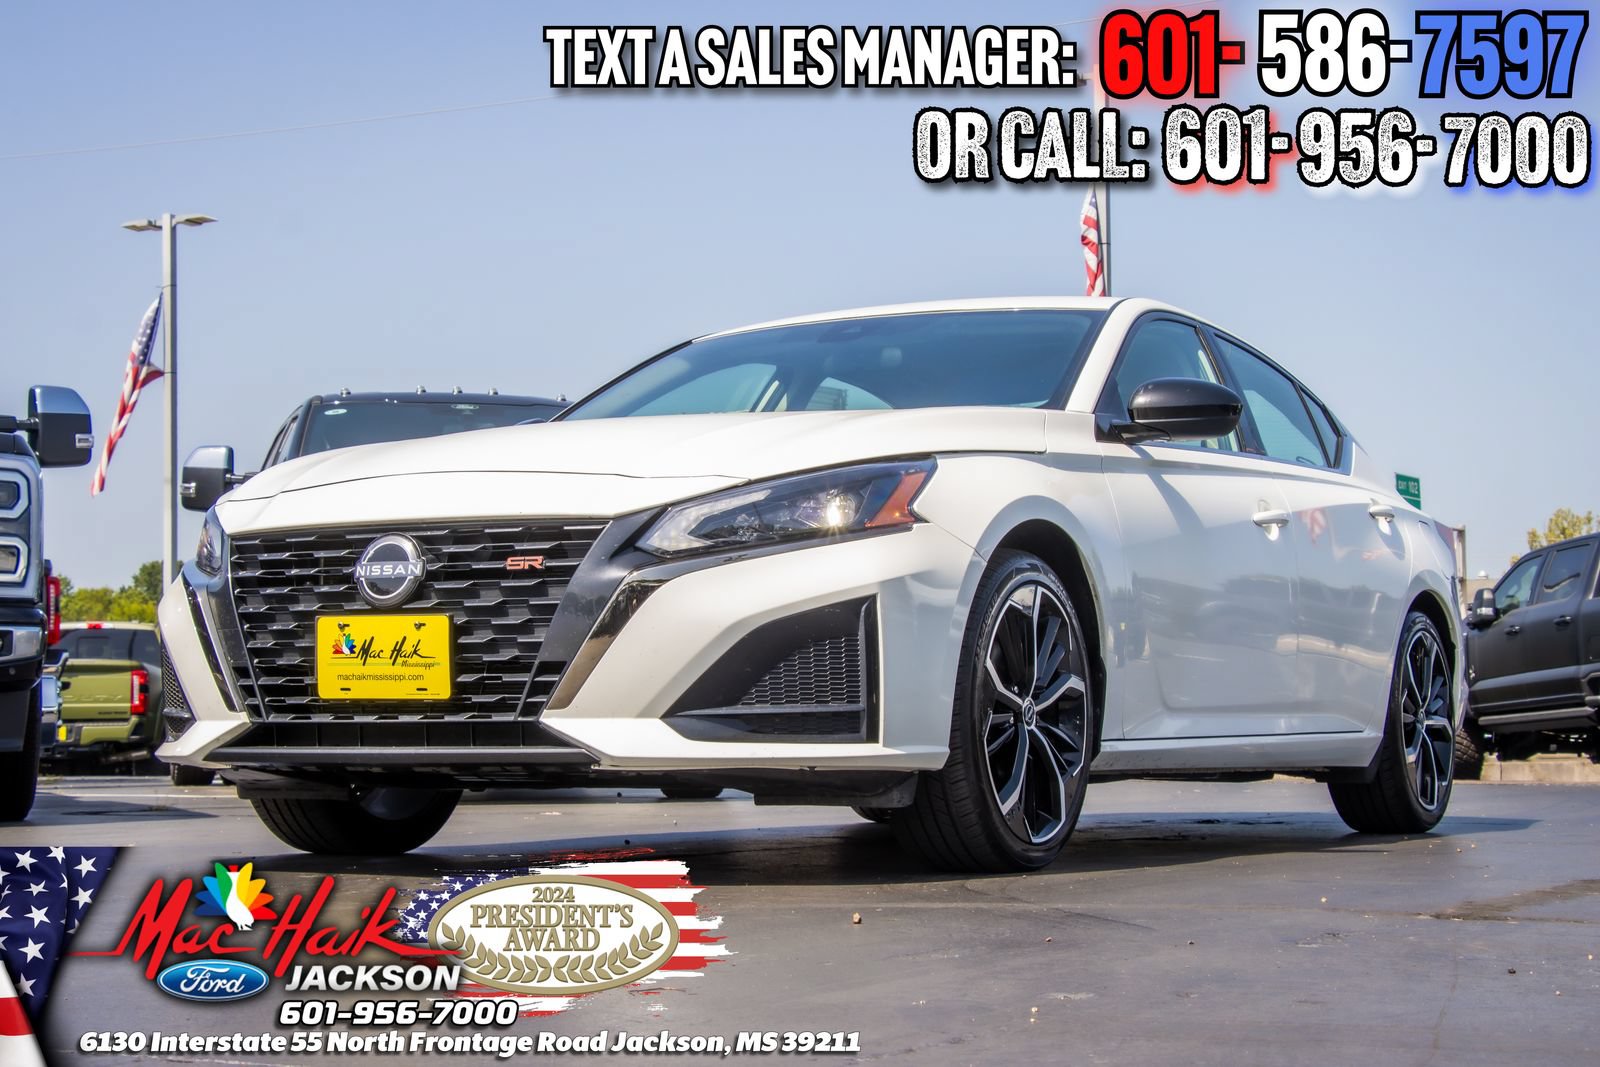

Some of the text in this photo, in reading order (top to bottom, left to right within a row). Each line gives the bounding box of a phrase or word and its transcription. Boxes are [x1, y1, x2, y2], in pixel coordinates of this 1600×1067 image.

[1408, 480, 1418, 494] 102
[506, 556, 545, 570] SR
[356, 564, 421, 577] NISSAN
[357, 636, 428, 667] Mac Haik
[401, 660, 435, 670] Mississippi
[337, 673, 424, 682] machaikmississippi.com
